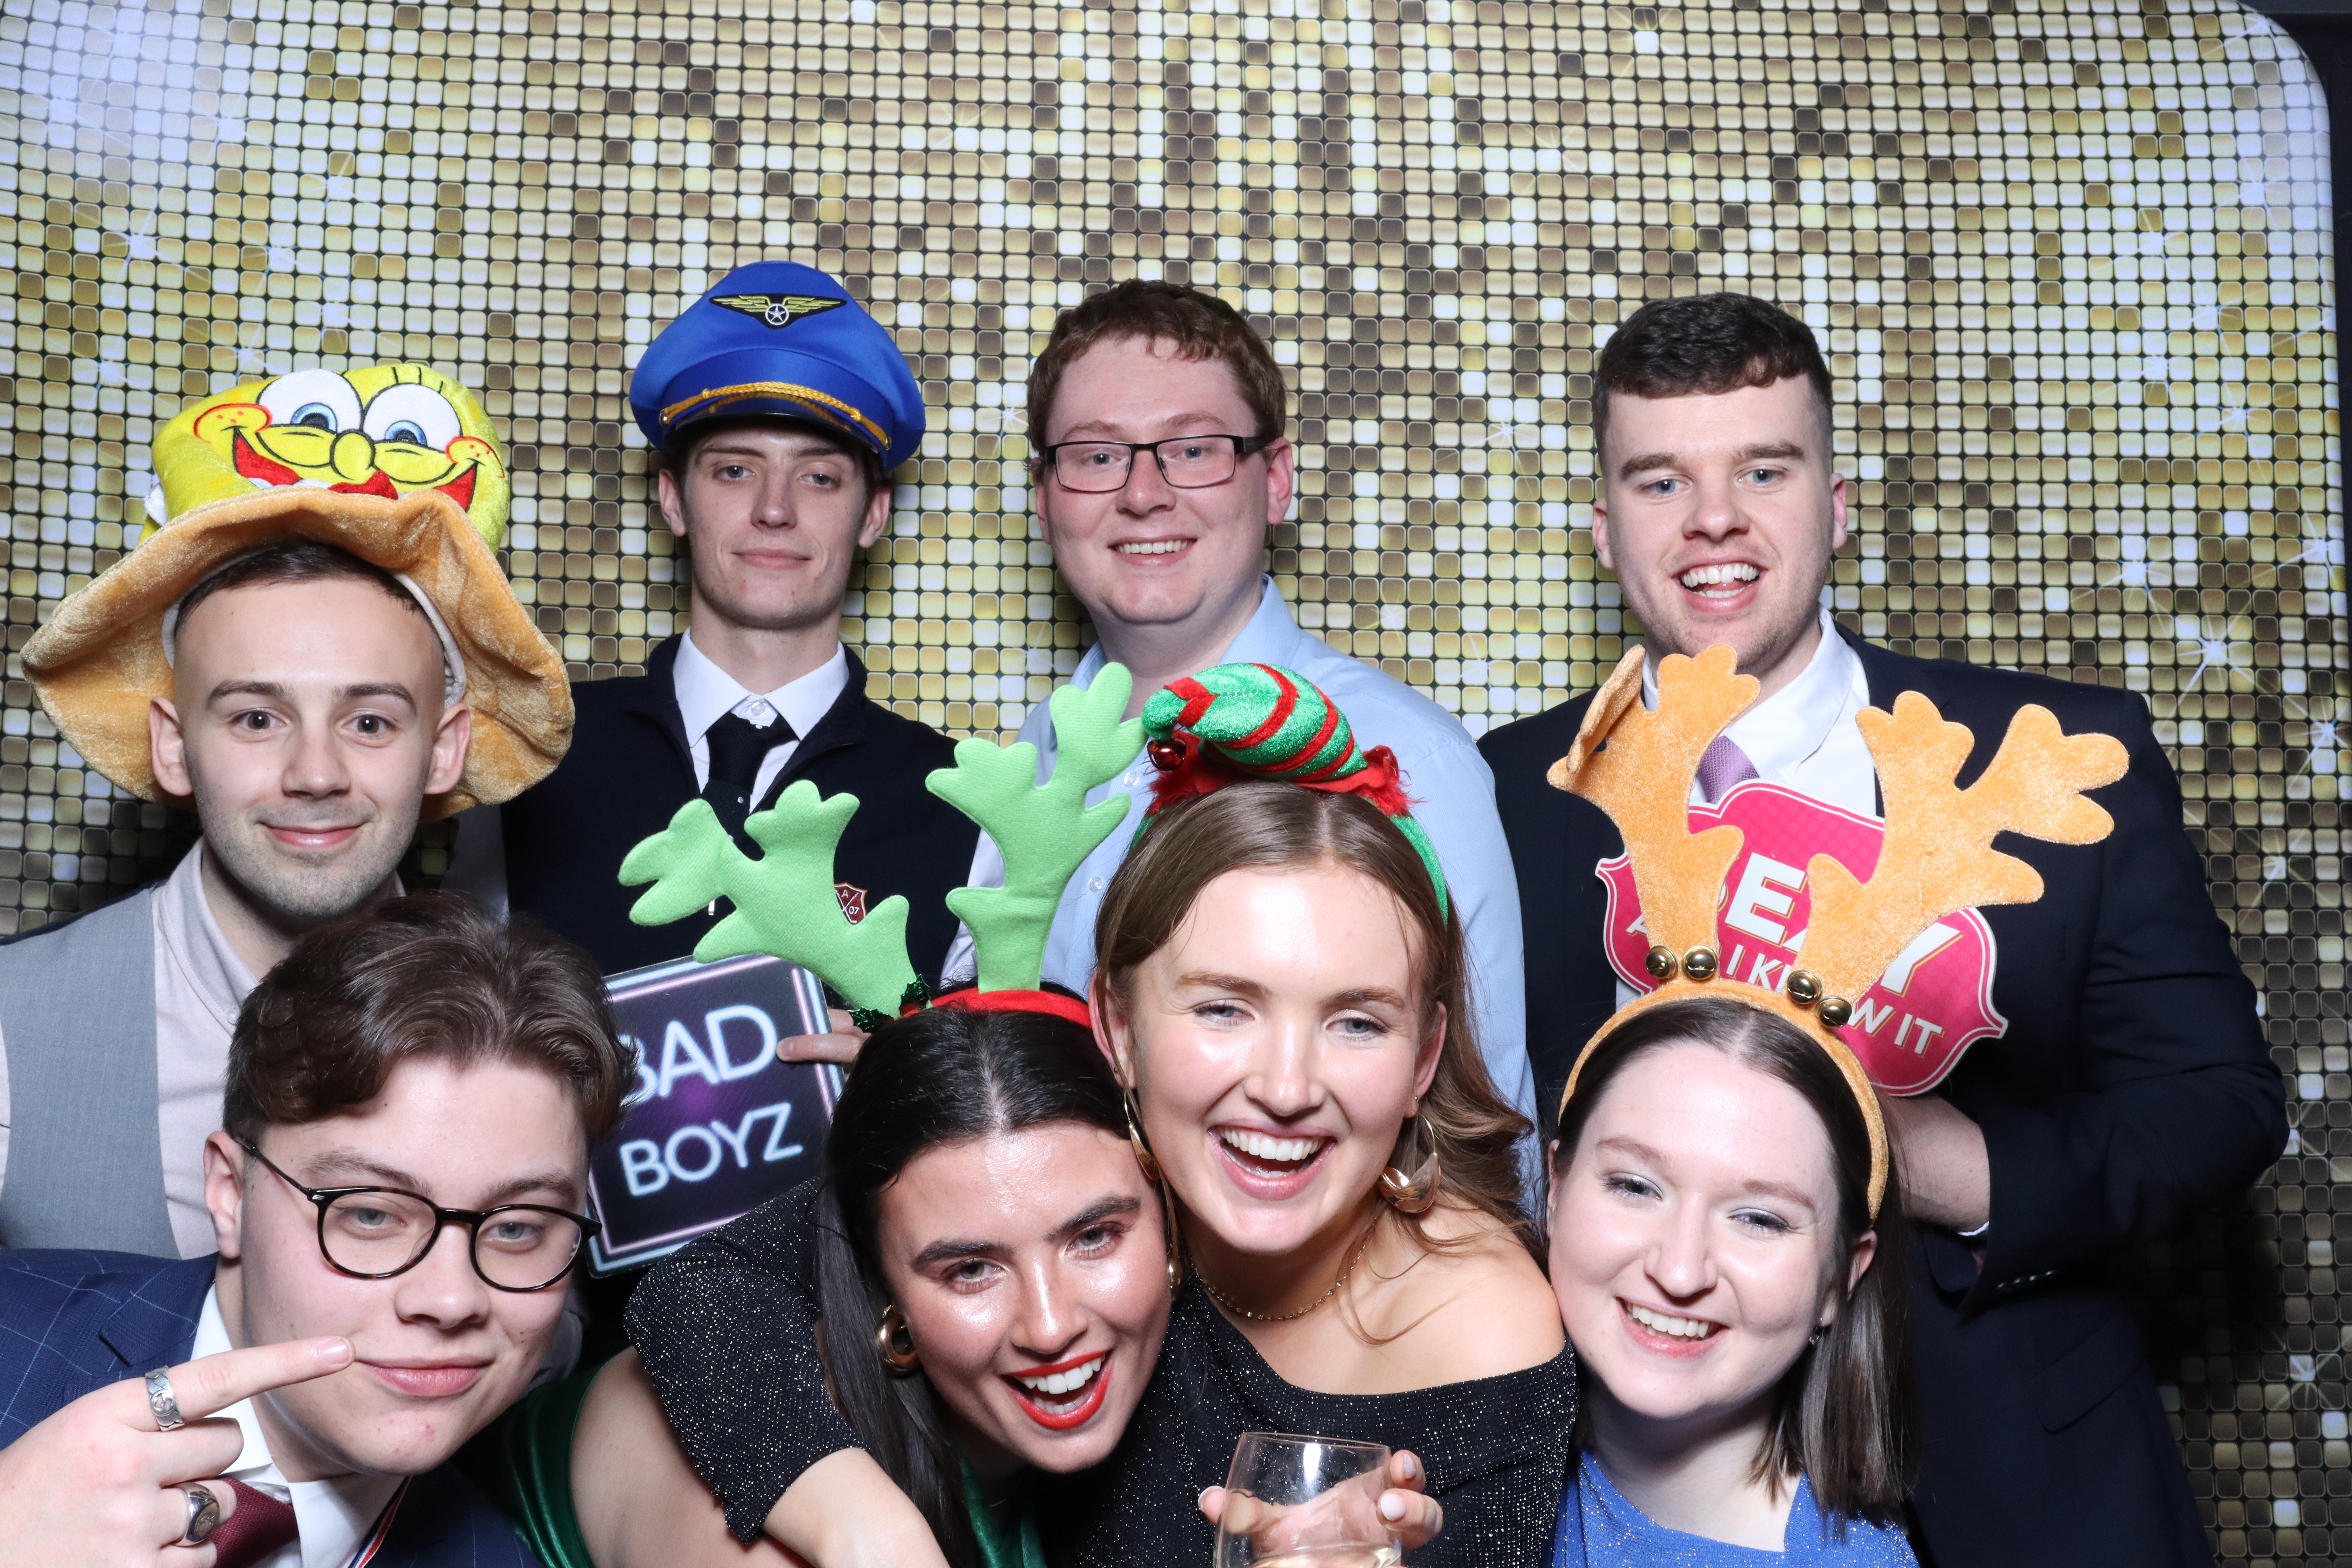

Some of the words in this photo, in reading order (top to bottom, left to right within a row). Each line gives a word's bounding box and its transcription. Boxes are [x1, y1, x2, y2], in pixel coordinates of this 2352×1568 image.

[841, 889, 849, 898] A
[848, 906, 860, 915] 07
[1894, 1013, 1944, 1055] IT
[617, 1004, 778, 1107] BAD
[620, 1102, 804, 1196] BOYZ
